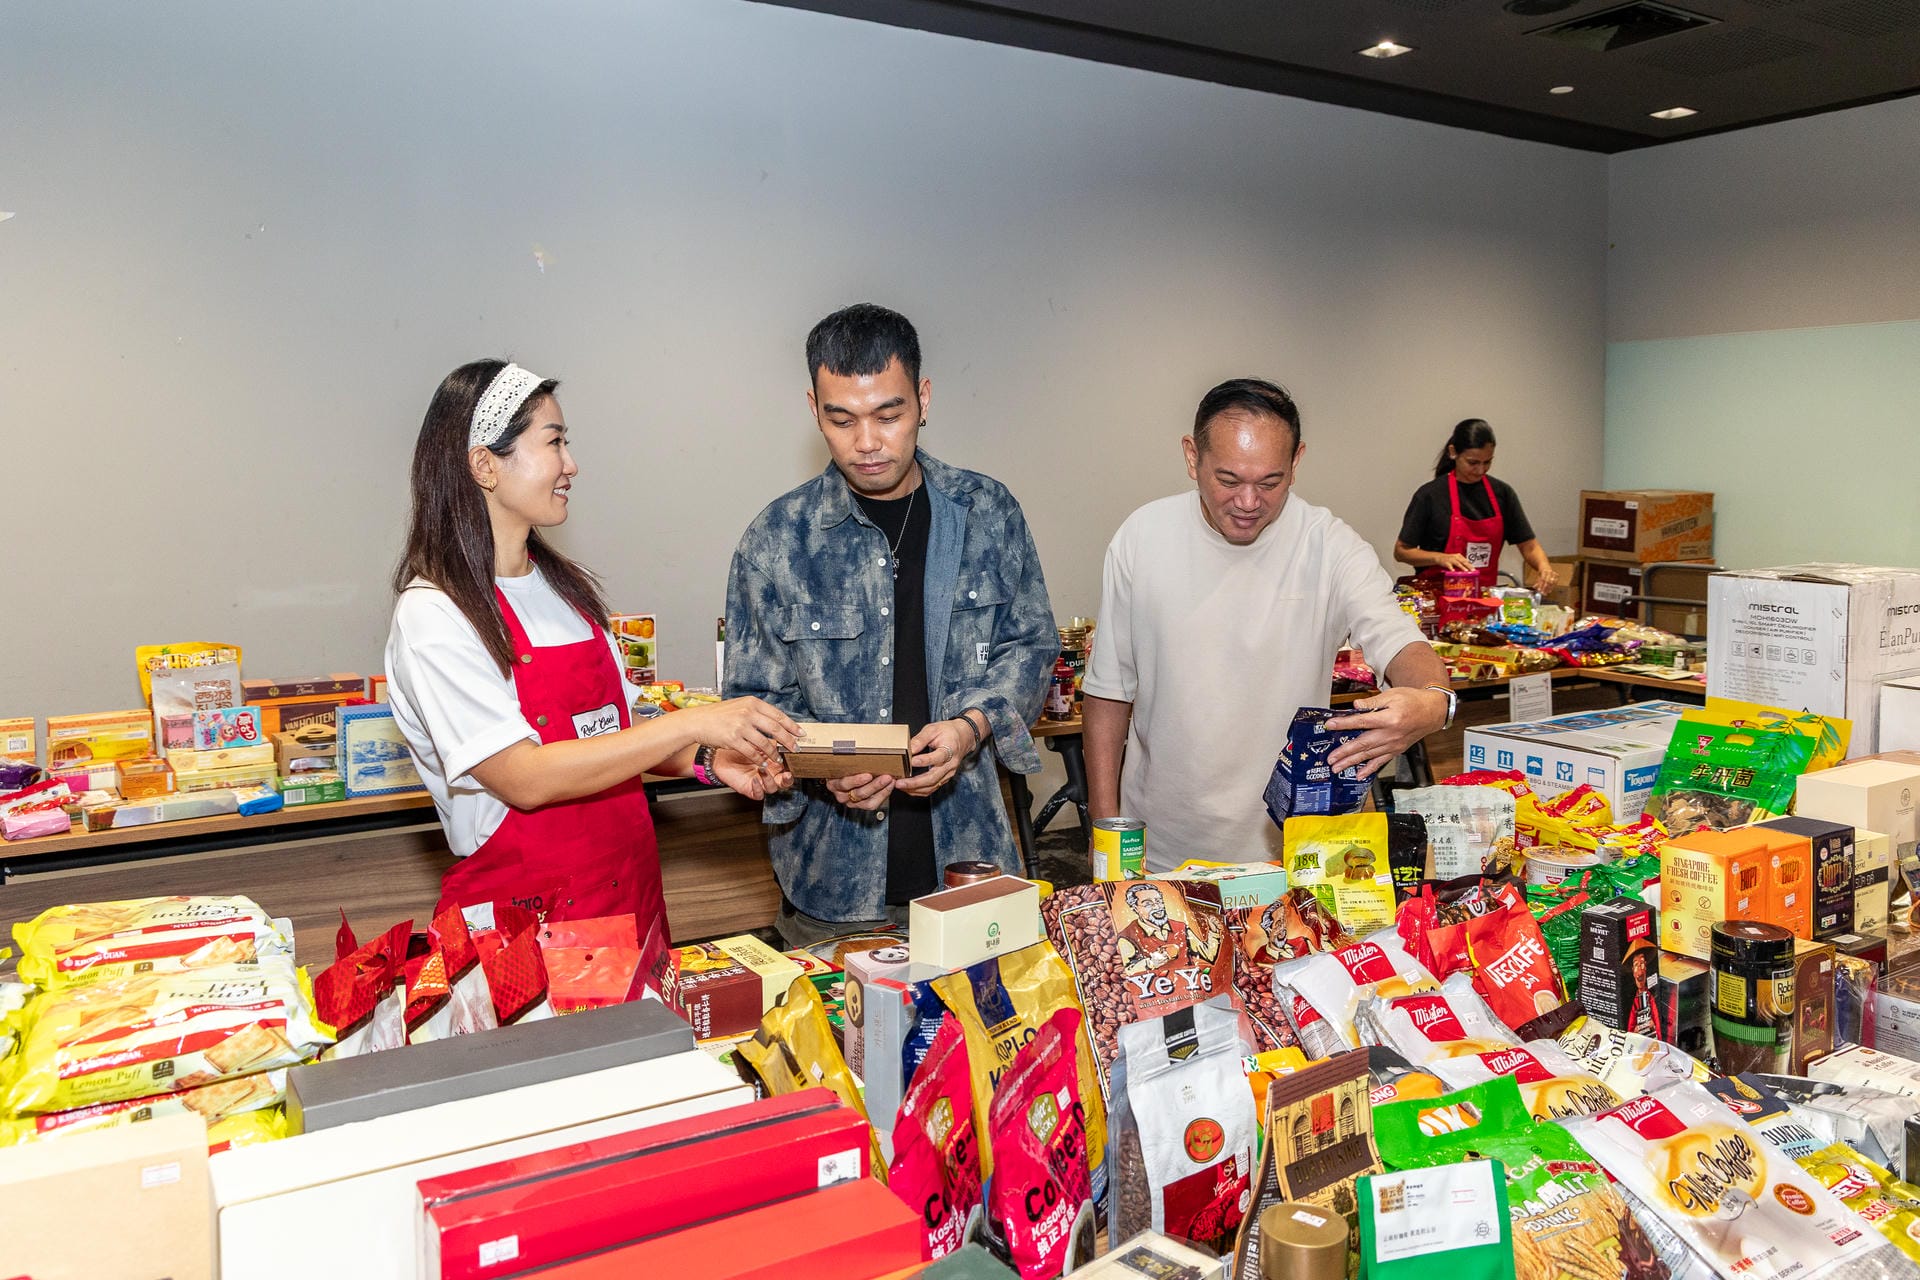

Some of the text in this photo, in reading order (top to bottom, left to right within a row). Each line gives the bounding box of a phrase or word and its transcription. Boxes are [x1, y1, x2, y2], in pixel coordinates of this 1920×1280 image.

[1748, 603, 1799, 615] mistral
[284, 711, 335, 732] VAN HOUTEN
[1471, 747, 1484, 756] 12
[1691, 763, 1756, 788] 牛肝菌
[1667, 865, 1718, 885] FRESH COFFEE
[1673, 856, 1711, 874] SINGAPORE
[1340, 944, 1378, 966] Mister
[1411, 1003, 1449, 1026] Mister
[159, 1062, 170, 1070] 12
[1488, 1049, 1529, 1073] Mister
[70, 1068, 142, 1091] Lemon Puff
[1614, 1097, 1656, 1122] Mister
[1697, 1134, 1754, 1184] Coffee
[1511, 1175, 1591, 1221] OA MALT
[1032, 1198, 1066, 1241] Kosong
[1528, 1207, 1578, 1232] DRINK
